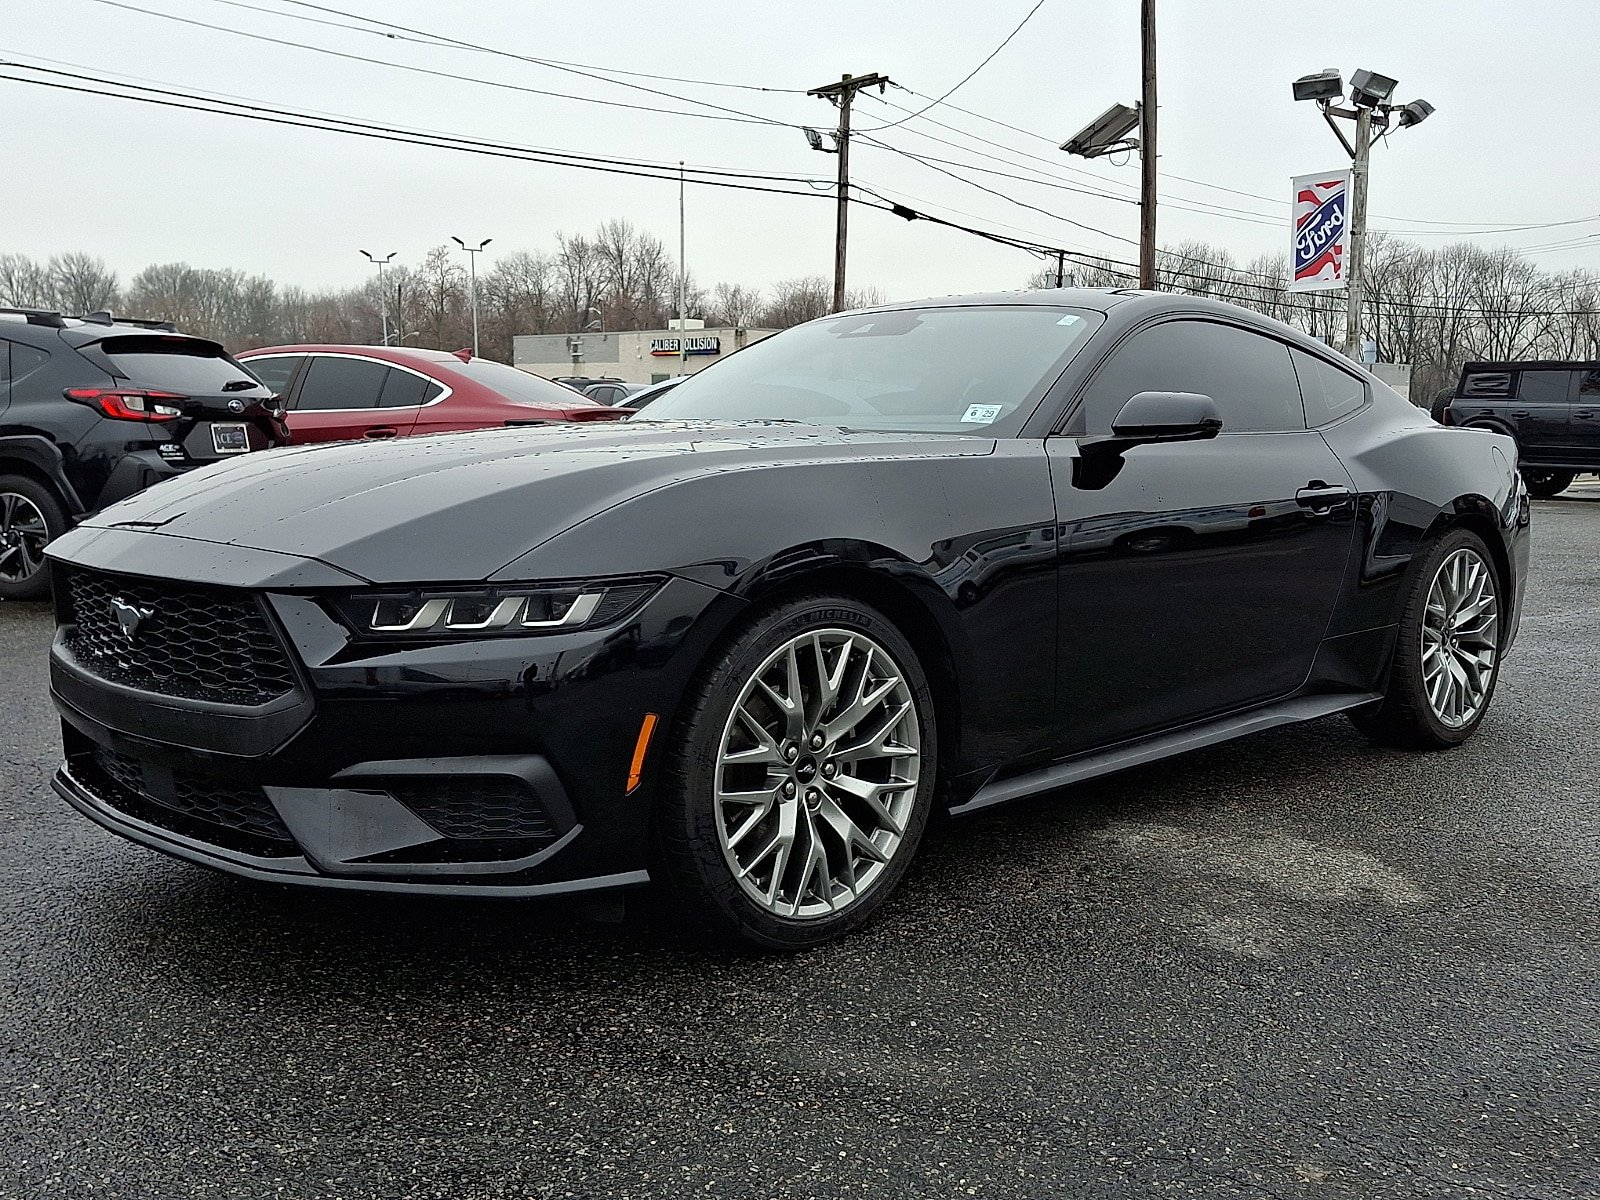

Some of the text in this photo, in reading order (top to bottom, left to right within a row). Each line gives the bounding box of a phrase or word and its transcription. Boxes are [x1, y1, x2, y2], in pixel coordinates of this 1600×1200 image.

[1297, 203, 1344, 259] Ford
[650, 338, 717, 350] CALIBER OLLISION
[216, 433, 232, 444] ACE
[809, 610, 870, 625] MICHELIN
